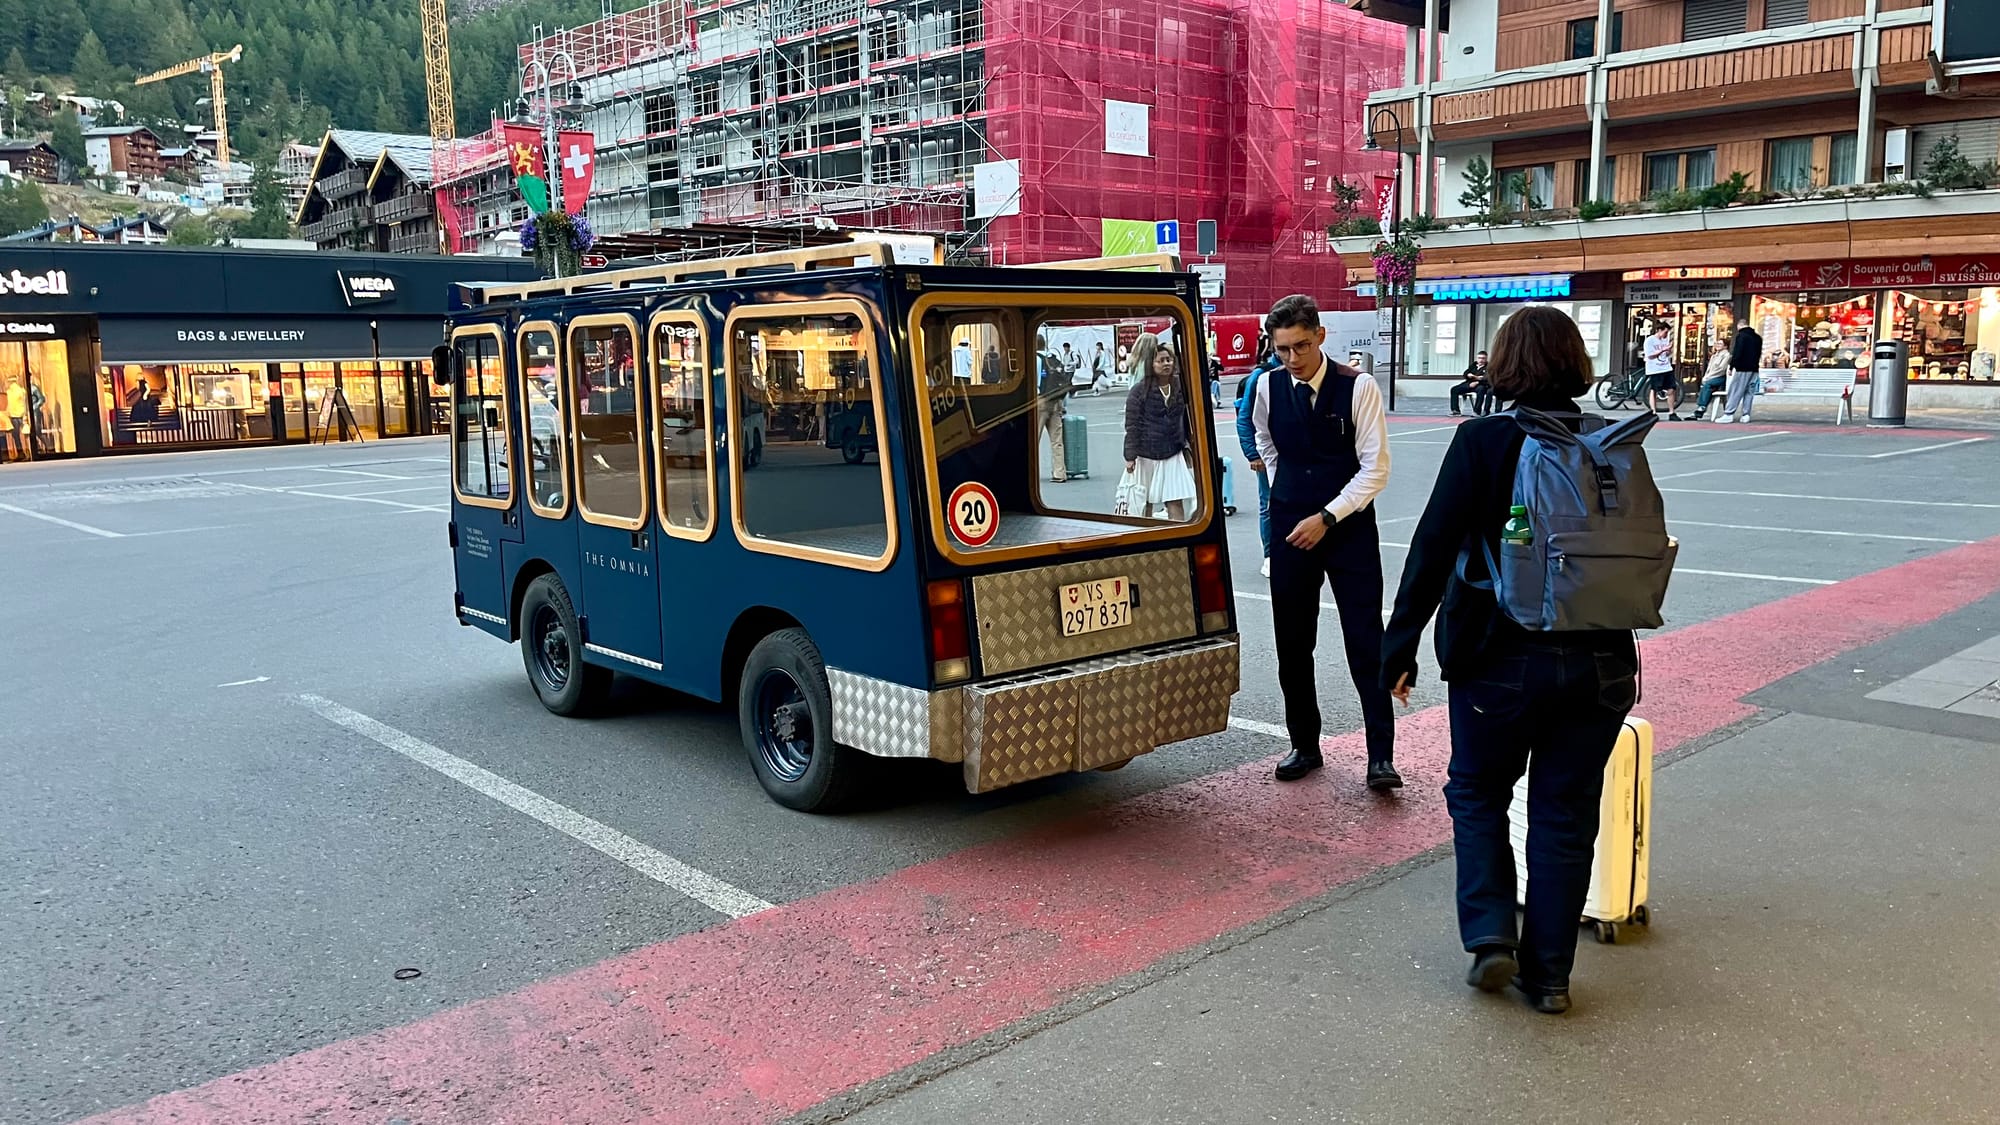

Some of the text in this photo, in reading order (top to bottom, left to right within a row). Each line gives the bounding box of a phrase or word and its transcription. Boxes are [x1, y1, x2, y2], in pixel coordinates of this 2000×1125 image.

[1706, 267, 1737, 279] SHOP
[1752, 268, 1800, 278] Victorinox
[1853, 263, 1900, 274] Souvenir
[1895, 275, 1913, 283] 50%
[1939, 272, 1976, 283] SWISS
[349, 277, 395, 291] WEGA
[1748, 280, 1802, 289] Free Engraving
[177, 330, 305, 341] BAGS & JEWELLERY
[961, 499, 986, 526] 20
[585, 551, 649, 577] THE OMNIA
[1086, 583, 1104, 602] VS
